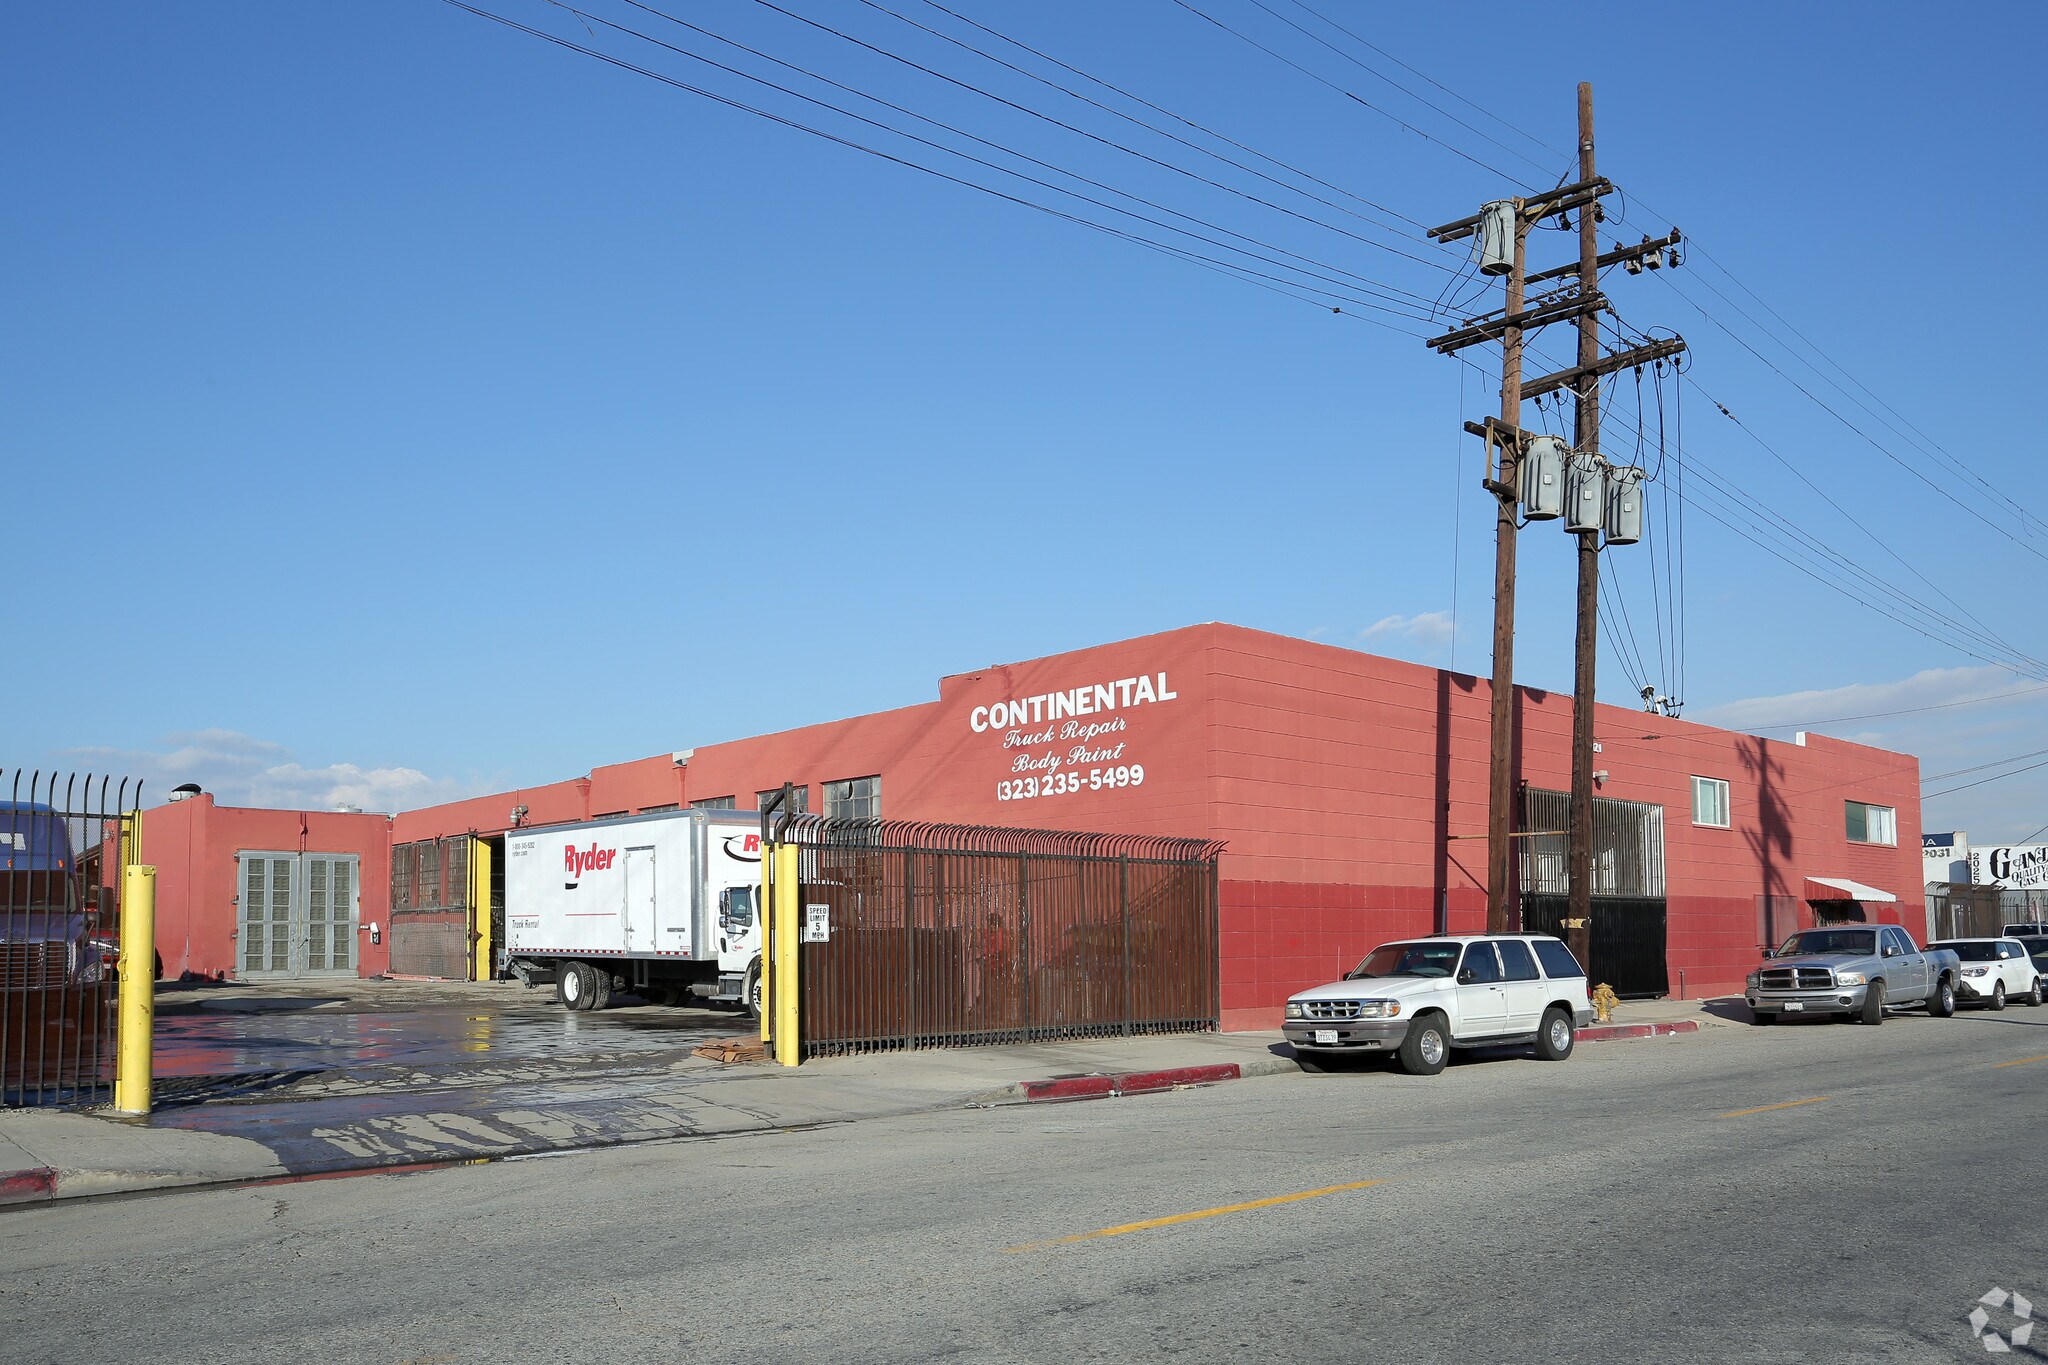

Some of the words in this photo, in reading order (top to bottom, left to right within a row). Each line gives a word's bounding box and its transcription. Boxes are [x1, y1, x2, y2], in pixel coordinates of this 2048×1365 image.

[970, 672, 1177, 733] CONTINENTAL
[1003, 725, 1055, 749] Truck
[1059, 716, 1127, 742] Repair
[1011, 750, 1062, 774] Body
[1066, 743, 1126, 766] Paint
[997, 776, 1040, 801] (323)
[1041, 764, 1144, 797] 235-5499
[565, 842, 616, 878] Ryder
[1972, 852, 1981, 885] 2025
[2011, 864, 2046, 883] QUALITY
[809, 907, 827, 915] SPEED
[810, 914, 826, 922] LIMIT
[512, 919, 524, 929] Truck
[525, 919, 539, 929] Rental
[811, 931, 825, 939] MPH
[815, 922, 821, 931] 5
